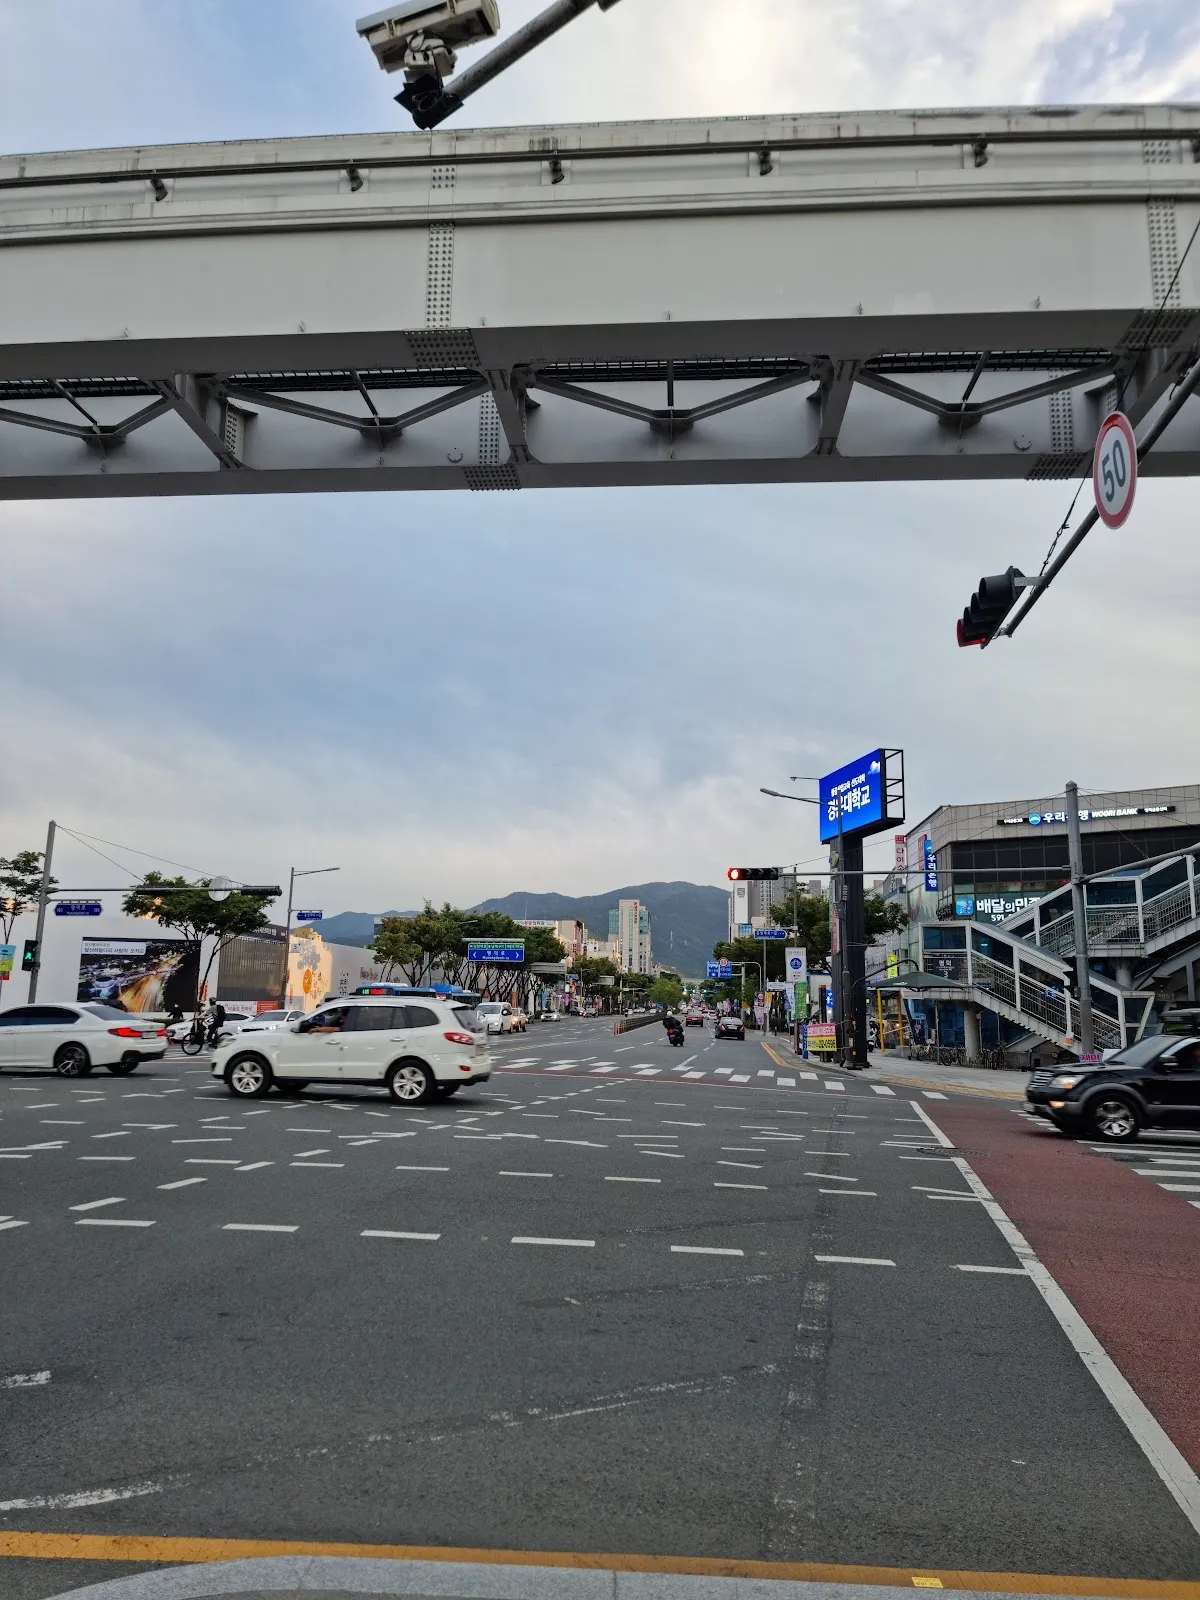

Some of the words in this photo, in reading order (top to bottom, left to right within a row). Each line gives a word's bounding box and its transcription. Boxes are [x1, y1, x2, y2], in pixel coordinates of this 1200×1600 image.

[1102, 440, 1126, 502] 50
[1043, 810, 1089, 824] 우리행
[1092, 810, 1116, 818] WOORI
[1116, 808, 1138, 816] BANK
[938, 959, 952, 967] 명덕
[943, 970, 949, 978] 3
